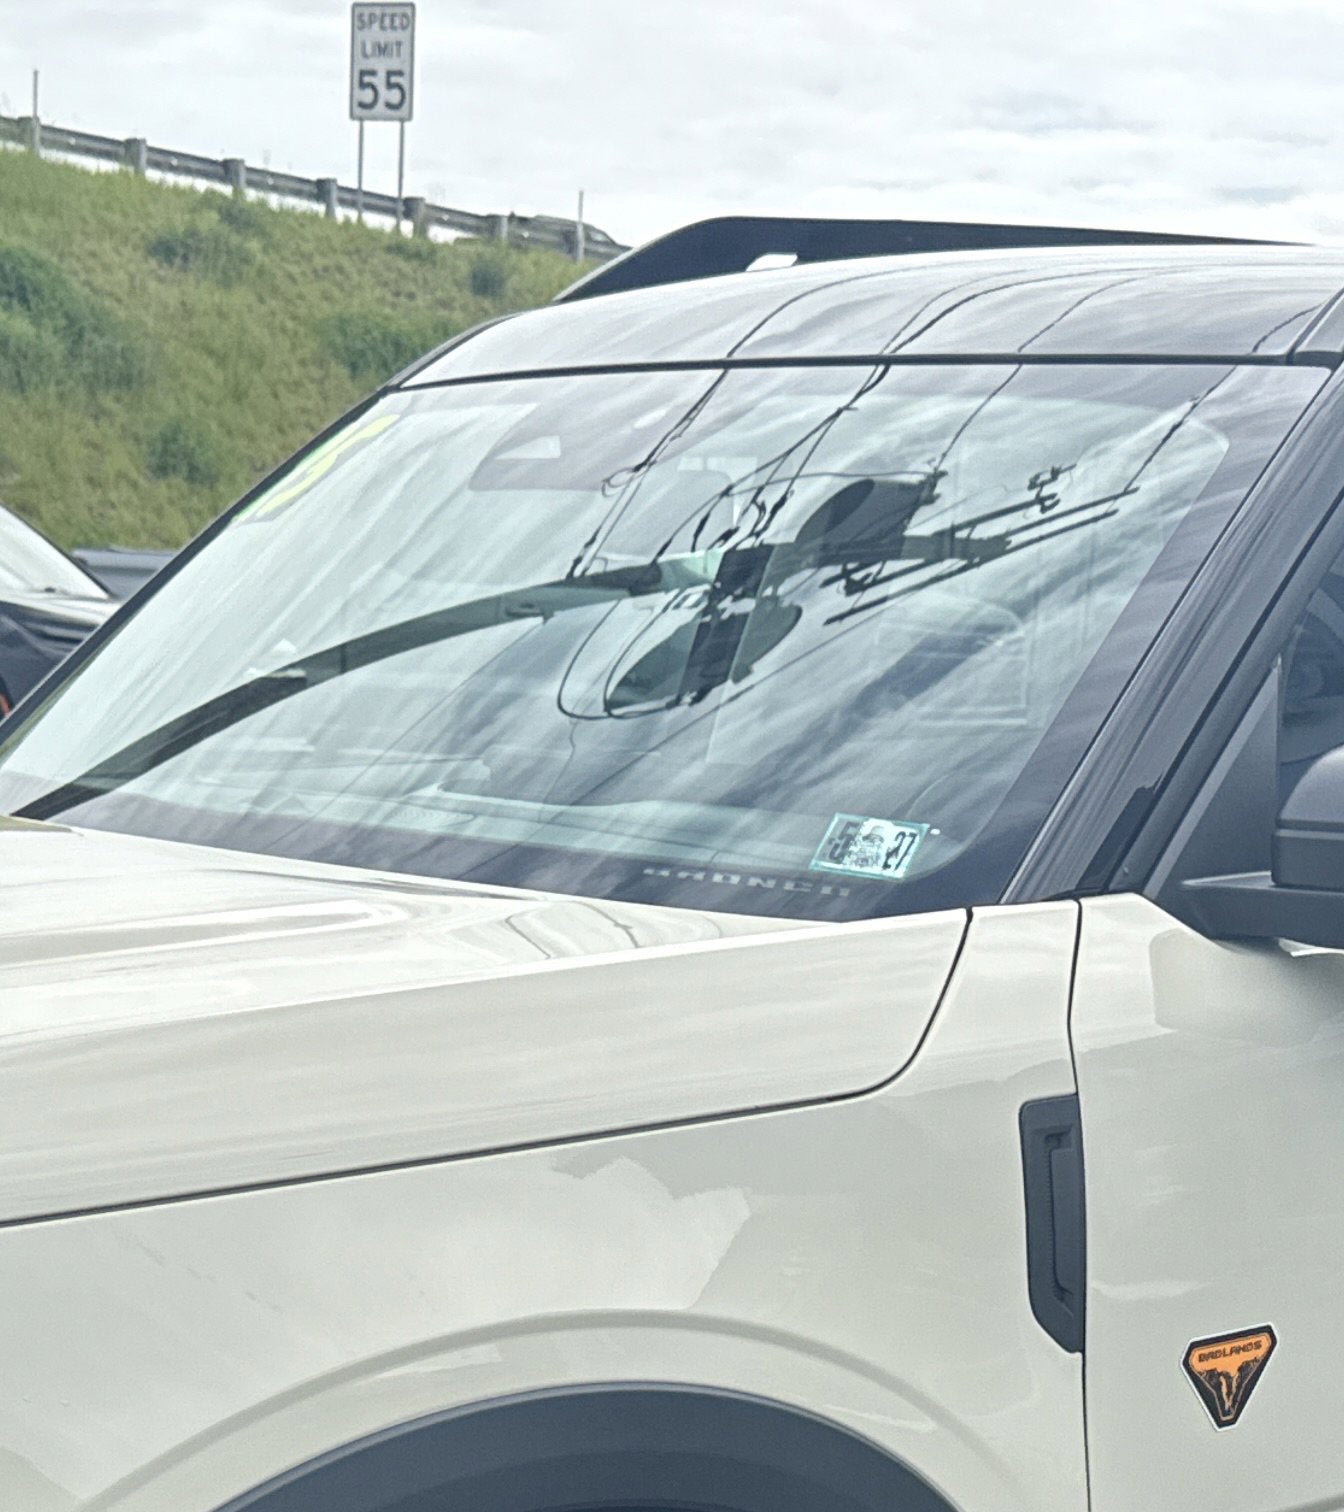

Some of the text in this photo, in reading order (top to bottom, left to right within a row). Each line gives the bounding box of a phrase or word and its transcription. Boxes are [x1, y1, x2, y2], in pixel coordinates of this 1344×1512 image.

[357, 12, 411, 31] SPEED
[361, 41, 403, 58] LIMIT
[357, 69, 407, 111] 55
[828, 821, 918, 871] 5 27
[1197, 1340, 1262, 1362] BADLANDS
